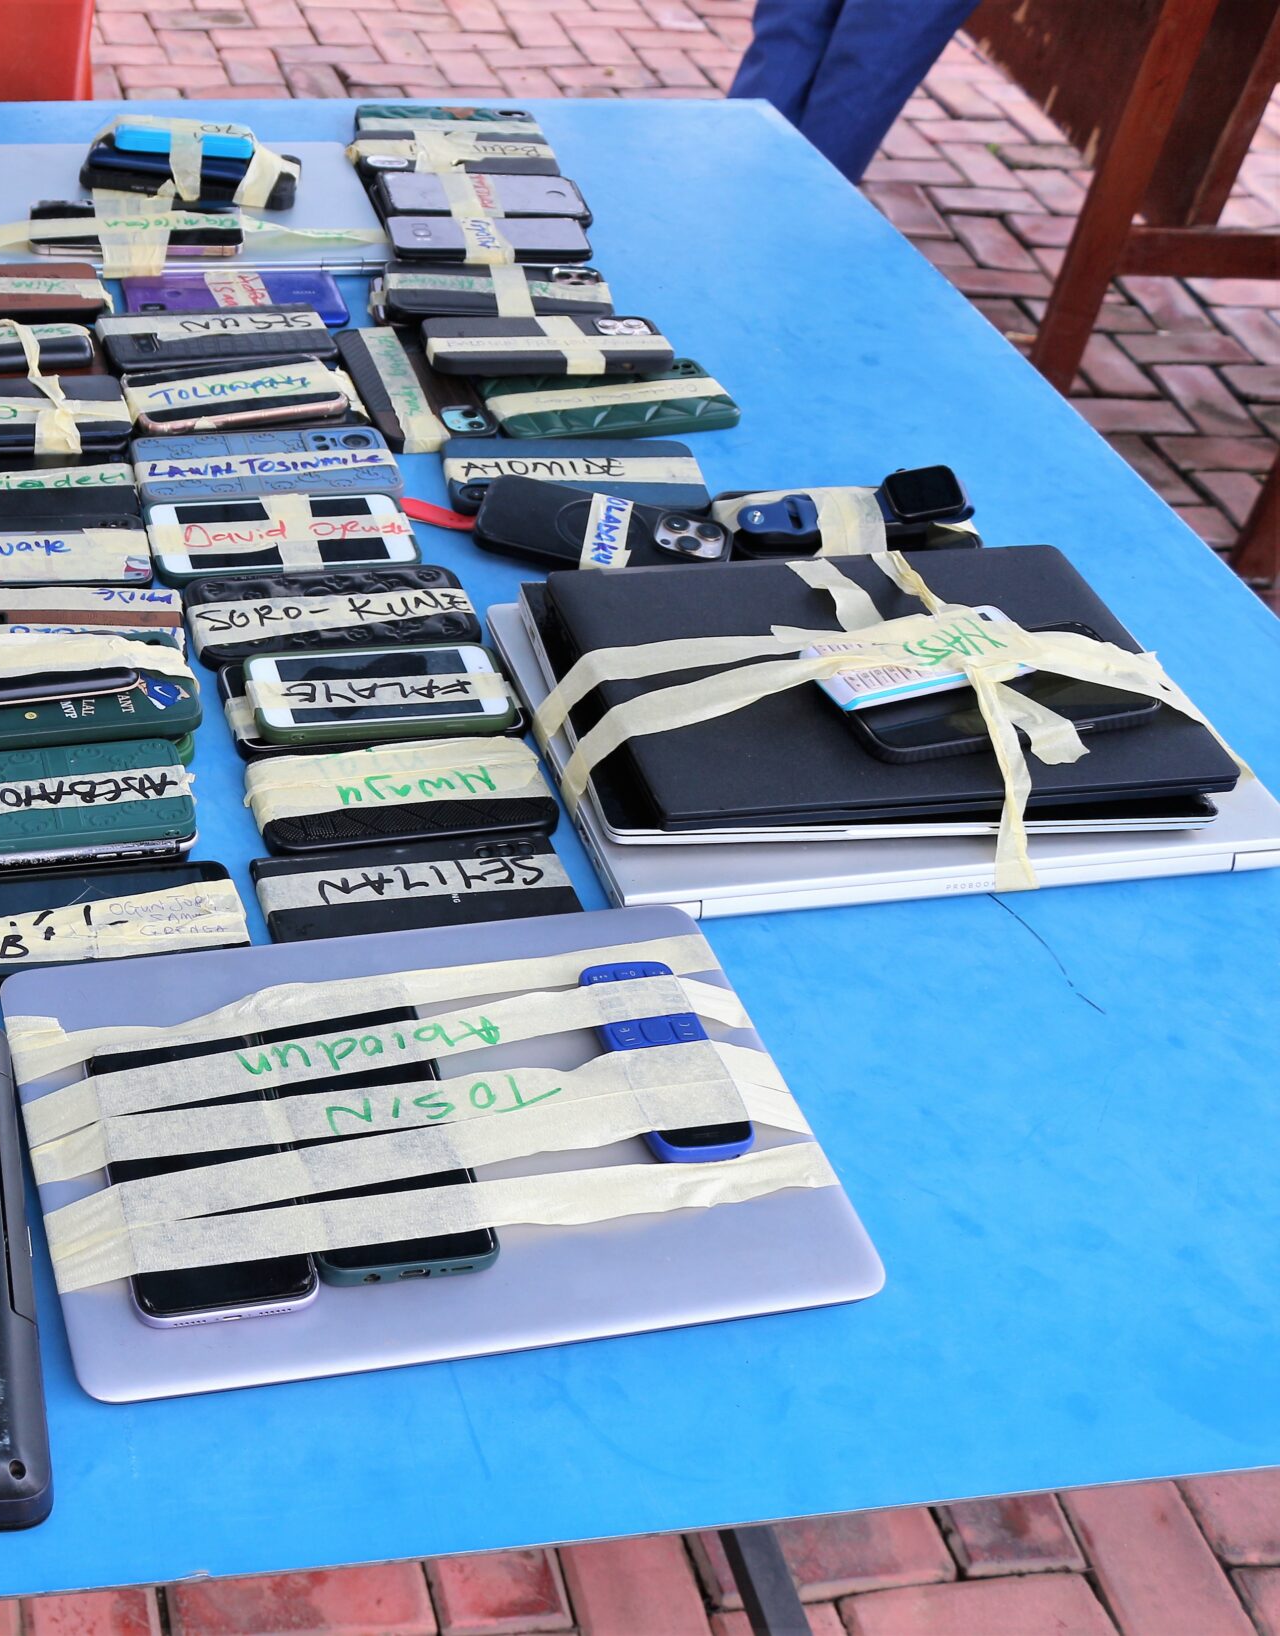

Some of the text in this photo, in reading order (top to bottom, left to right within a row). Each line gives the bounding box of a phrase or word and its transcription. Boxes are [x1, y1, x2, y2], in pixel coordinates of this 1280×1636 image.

[179, 313, 312, 333] SEGUN
[460, 457, 626, 478] AYOMIDE
[183, 520, 288, 548] David
[279, 679, 474, 703] FALAYE
